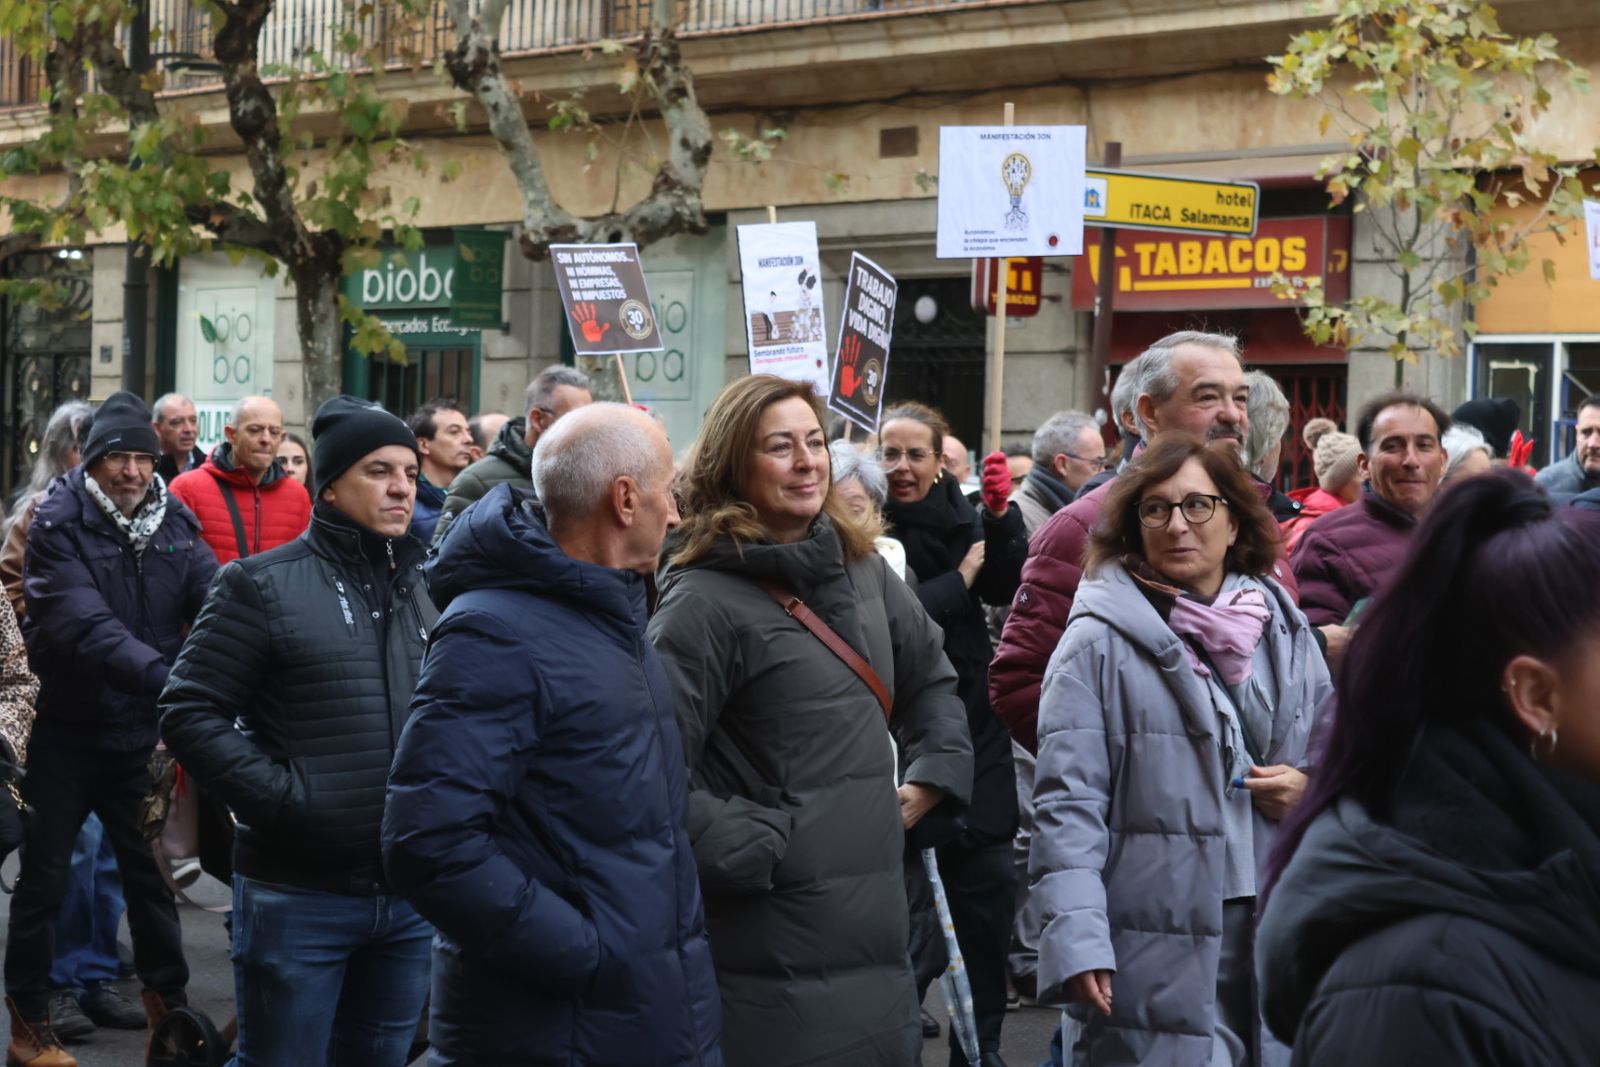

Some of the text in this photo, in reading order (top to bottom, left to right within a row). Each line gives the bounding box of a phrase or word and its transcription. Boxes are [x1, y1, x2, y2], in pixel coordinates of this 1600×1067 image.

[980, 131, 1035, 141] MANIFESTACIÓN
[1216, 190, 1252, 209] hotel
[1129, 203, 1250, 228] ITACA Salamanca
[557, 252, 573, 264] SIN
[1134, 236, 1307, 277] TABACOS
[565, 267, 575, 277] NI
[568, 279, 578, 289] NI
[572, 289, 627, 301] NI IMPUESTOS
[856, 266, 893, 309] TRABAJO
[991, 292, 1037, 306] TBACOS
[627, 310, 644, 325] 30
[651, 293, 686, 334] io
[858, 291, 886, 330] DIGNO,
[214, 301, 252, 343] bio
[848, 308, 868, 337] VIDA
[213, 347, 251, 385] ba
